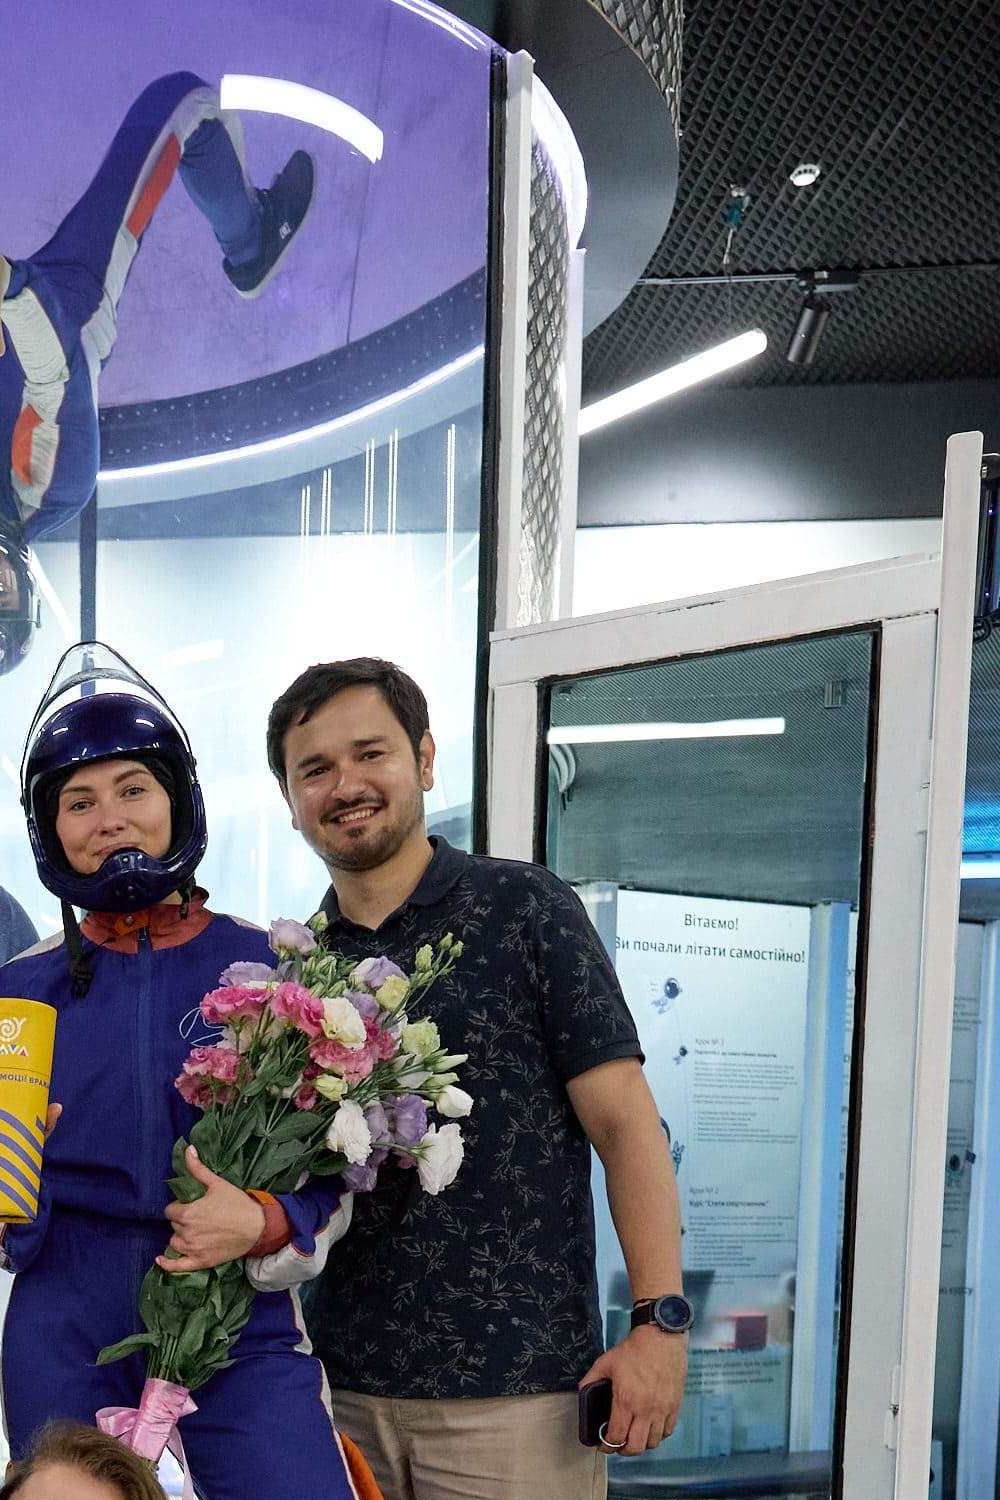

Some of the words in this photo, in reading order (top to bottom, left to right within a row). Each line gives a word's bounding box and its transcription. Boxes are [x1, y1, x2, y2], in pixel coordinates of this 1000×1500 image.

[684, 914, 739, 930] Вітаємо!
[633, 940, 682, 954] почали
[685, 942, 726, 957] літати
[729, 947, 806, 963] самостійно!
